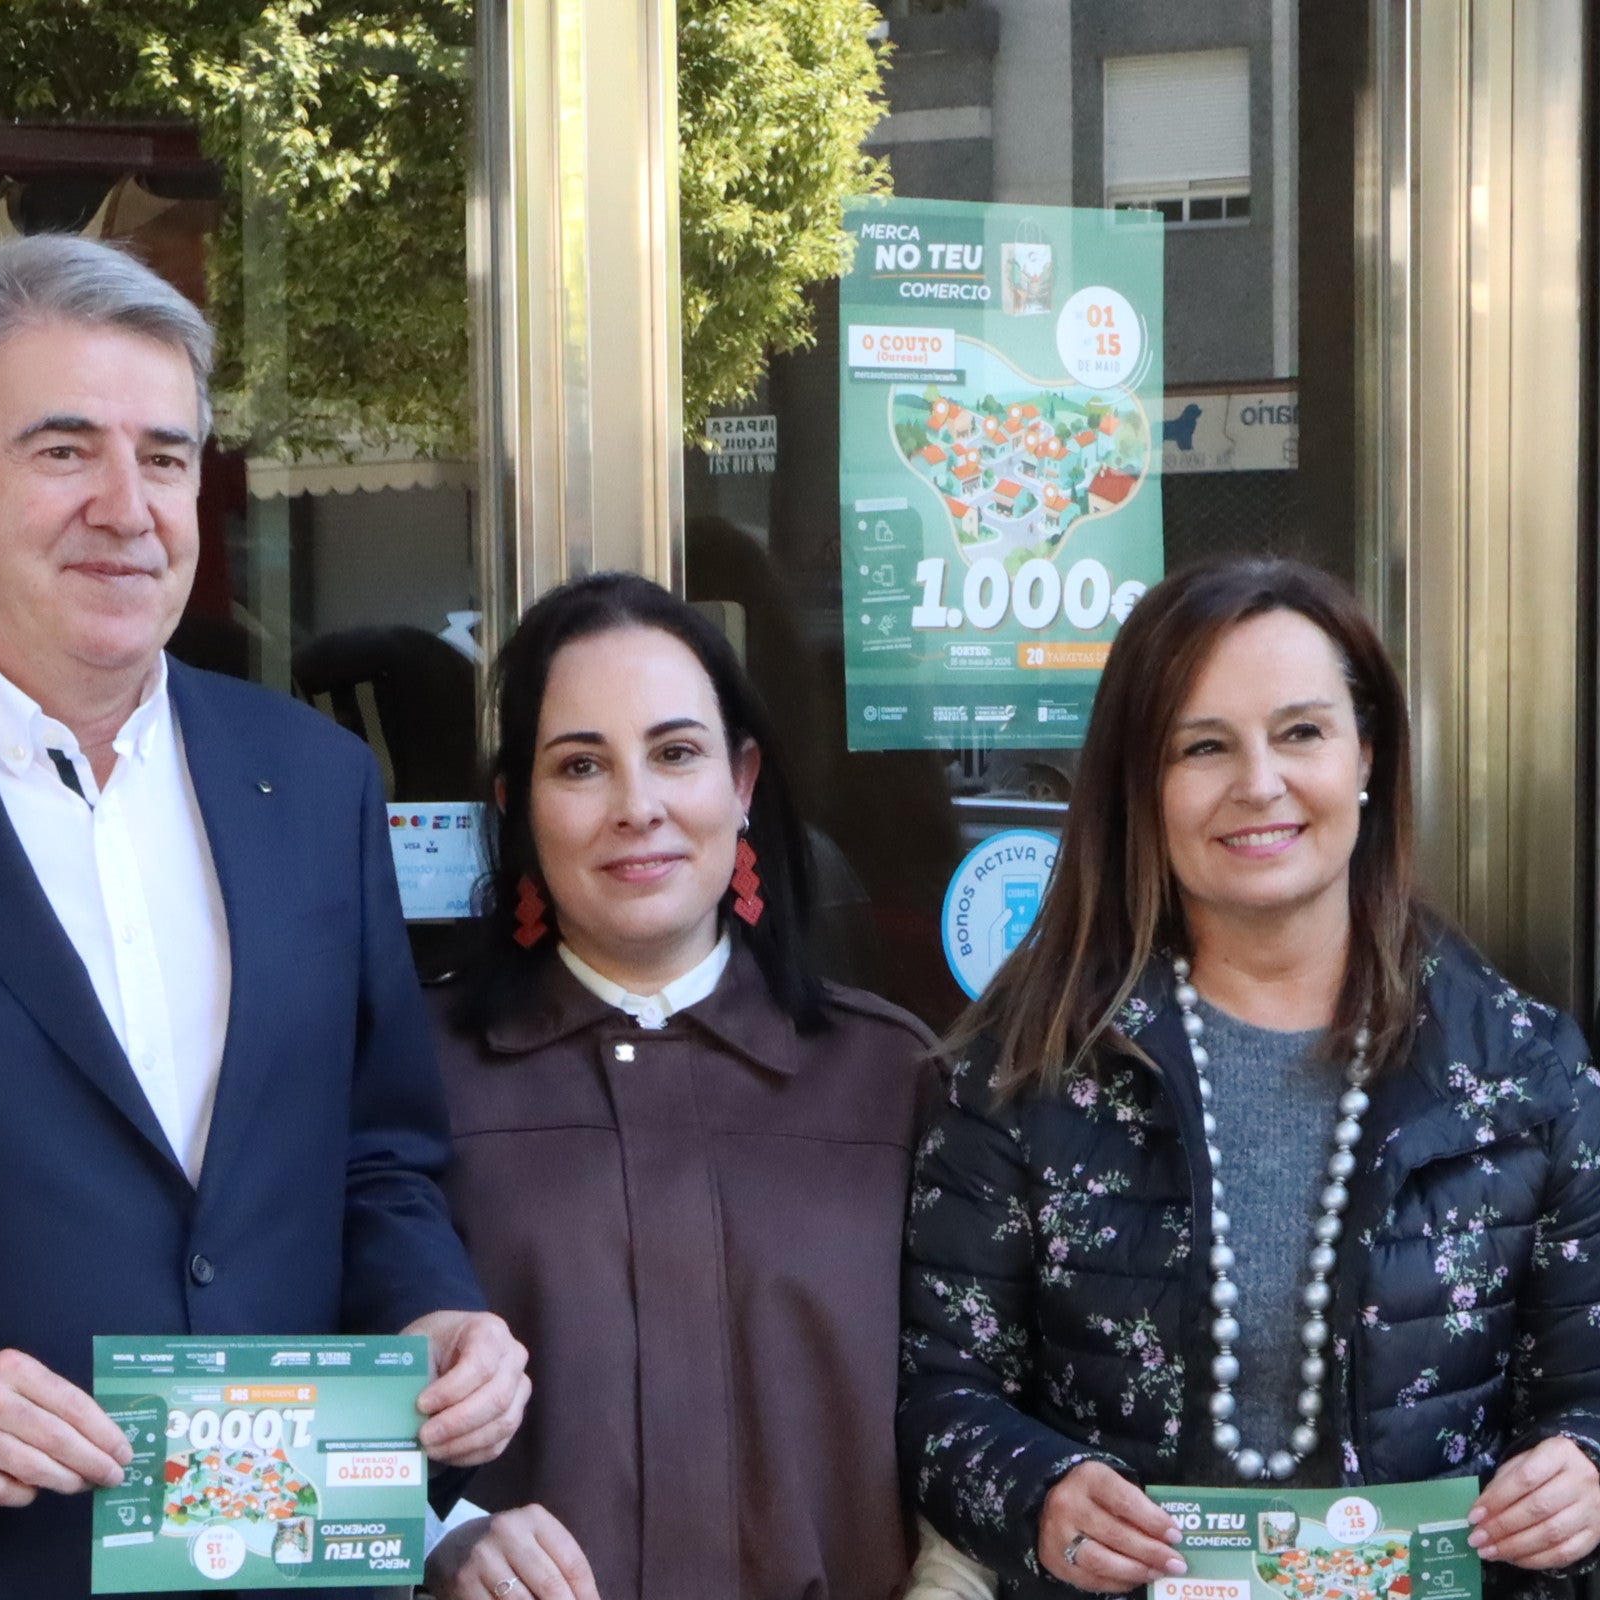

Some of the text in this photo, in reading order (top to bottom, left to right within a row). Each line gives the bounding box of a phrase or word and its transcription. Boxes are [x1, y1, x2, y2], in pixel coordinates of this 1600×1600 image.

[861, 223, 920, 241] MERCA
[875, 244, 983, 270] NO TEU
[900, 282, 991, 300] COMERCIO
[1087, 304, 1115, 327] 01
[862, 334, 942, 352] O COUTO
[1096, 334, 1121, 356] 15
[877, 352, 928, 364] (Ourense)
[1078, 360, 1090, 372] DE
[911, 558, 1148, 630] 1.000€
[1026, 648, 1044, 665] 20
[975, 846, 1037, 881] ACTIVA
[165, 1408, 315, 1450] 1.000€
[339, 1466, 410, 1480] O COUTO
[1160, 1502, 1201, 1513] MERCA
[1344, 1505, 1362, 1516] 01
[321, 1524, 386, 1535] COMERCIO
[1206, 1514, 1245, 1530] TEU
[1350, 1517, 1365, 1528] 15
[1186, 1536, 1252, 1547] COMERCIO
[325, 1540, 401, 1560] NO TEU
[369, 1559, 410, 1570] MERCA
[1166, 1584, 1239, 1598] O COUTO
